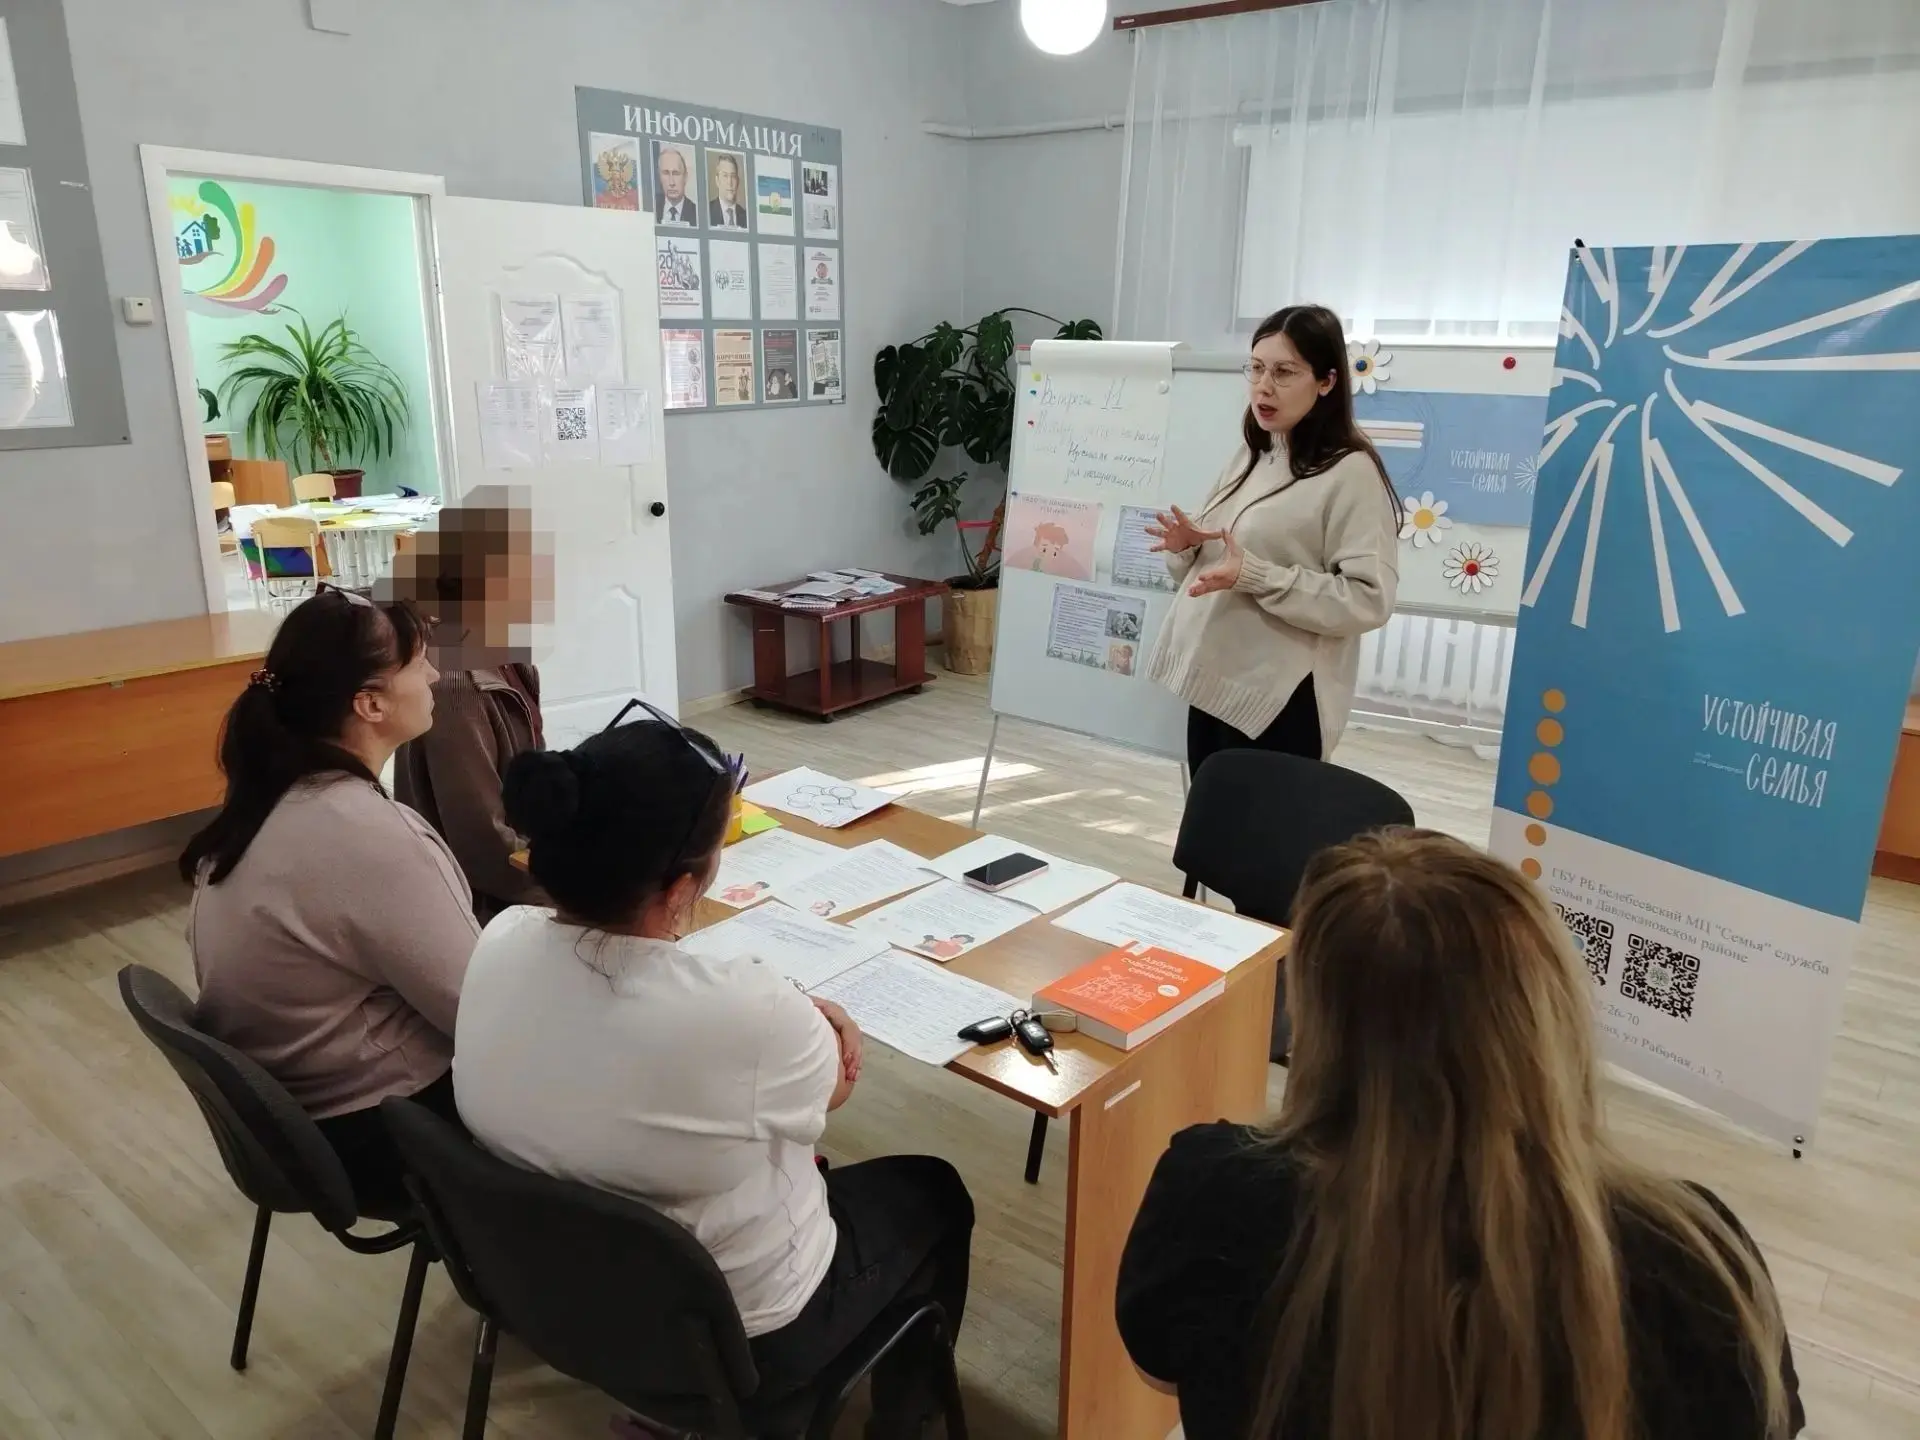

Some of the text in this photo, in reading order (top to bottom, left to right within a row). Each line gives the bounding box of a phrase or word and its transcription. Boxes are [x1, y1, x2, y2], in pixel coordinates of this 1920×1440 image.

[622, 104, 803, 158] ИНФОРМАЦИЯ
[659, 254, 673, 269] 20
[660, 270, 673, 285] 26
[1450, 447, 1511, 471] УСТОЙЧИВАЯ
[1702, 693, 1838, 761] УСТОЙЧИВАЯ
[1549, 884, 1749, 964] семьи в Давлекановском районе
[1551, 867, 1577, 883] ГБУ
[1579, 876, 1595, 892] РБ
[1598, 883, 1683, 923] Белебеевский
[1685, 914, 1712, 936] МЦ
[1775, 949, 1830, 976] служба
